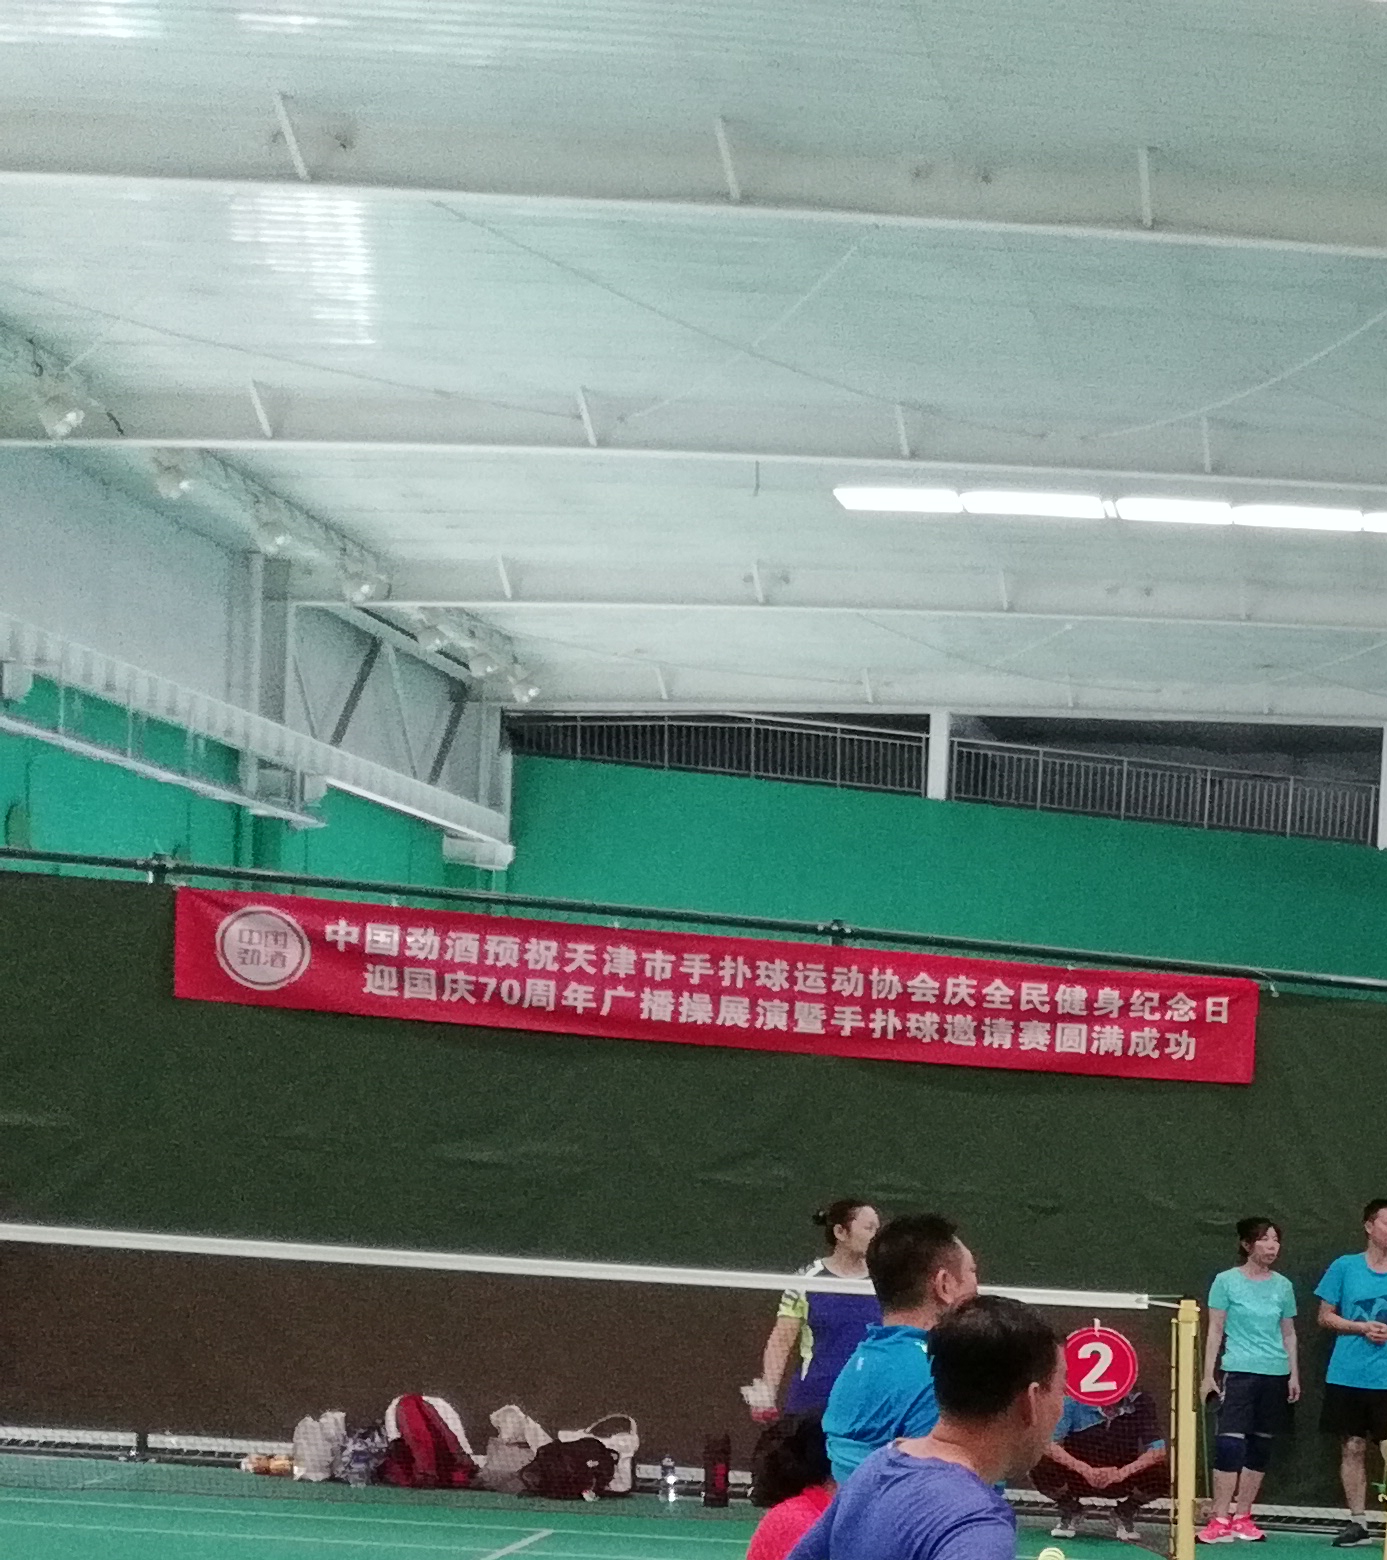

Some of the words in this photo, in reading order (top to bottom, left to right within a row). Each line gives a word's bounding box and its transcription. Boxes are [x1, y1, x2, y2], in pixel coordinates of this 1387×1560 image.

[325, 919, 1230, 1024] 中国劲酒预祝天津市手扑球运动协会庆全民健身纪念日
[363, 963, 1197, 1061] 迎国庆70周年广播操展演暨手扑球邀请赛圆满成功
[1077, 1341, 1118, 1393] 2
